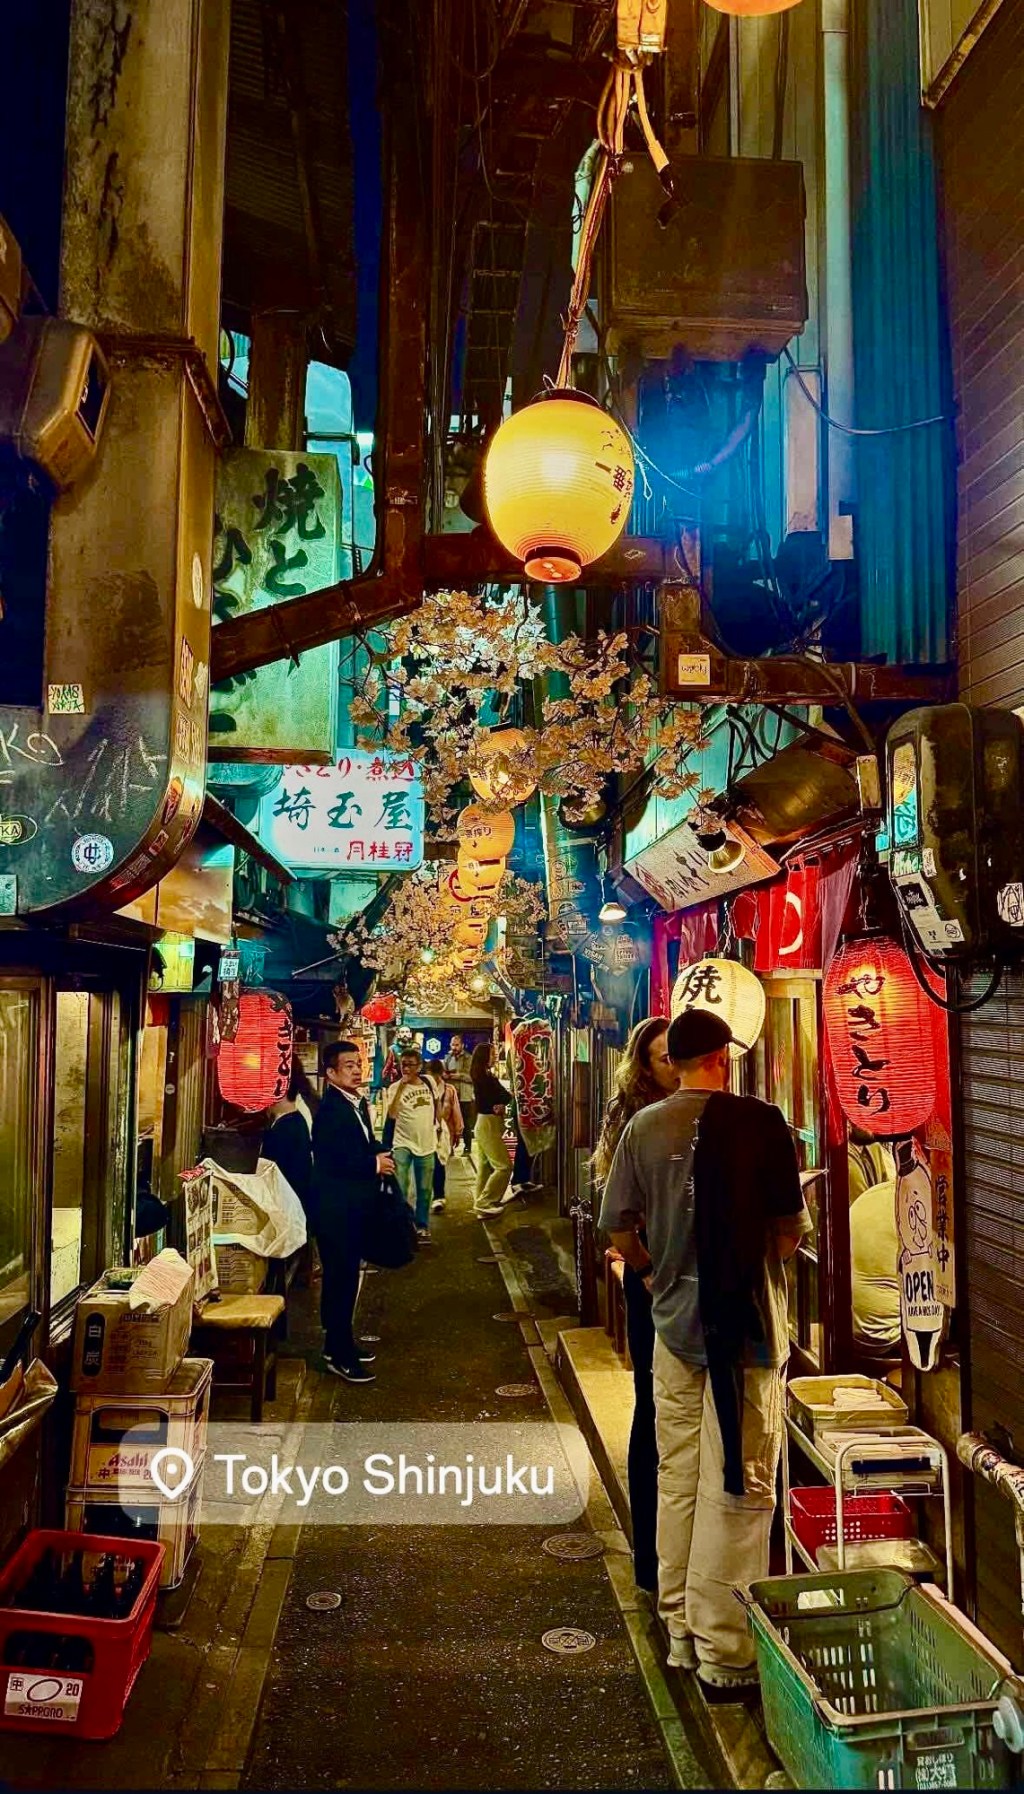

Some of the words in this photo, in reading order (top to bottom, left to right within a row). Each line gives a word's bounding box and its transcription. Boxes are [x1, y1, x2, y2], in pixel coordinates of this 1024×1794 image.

[273, 786, 413, 830] 埼玉屋
[347, 840, 413, 862] 月桂冠
[679, 965, 722, 1012] 焼
[835, 973, 891, 1116] やきとり
[935, 1173, 950, 1272] 営業中
[905, 1270, 935, 1302] OPEN
[108, 1452, 149, 1467] Asahi
[66, 1682, 80, 1697] 20
